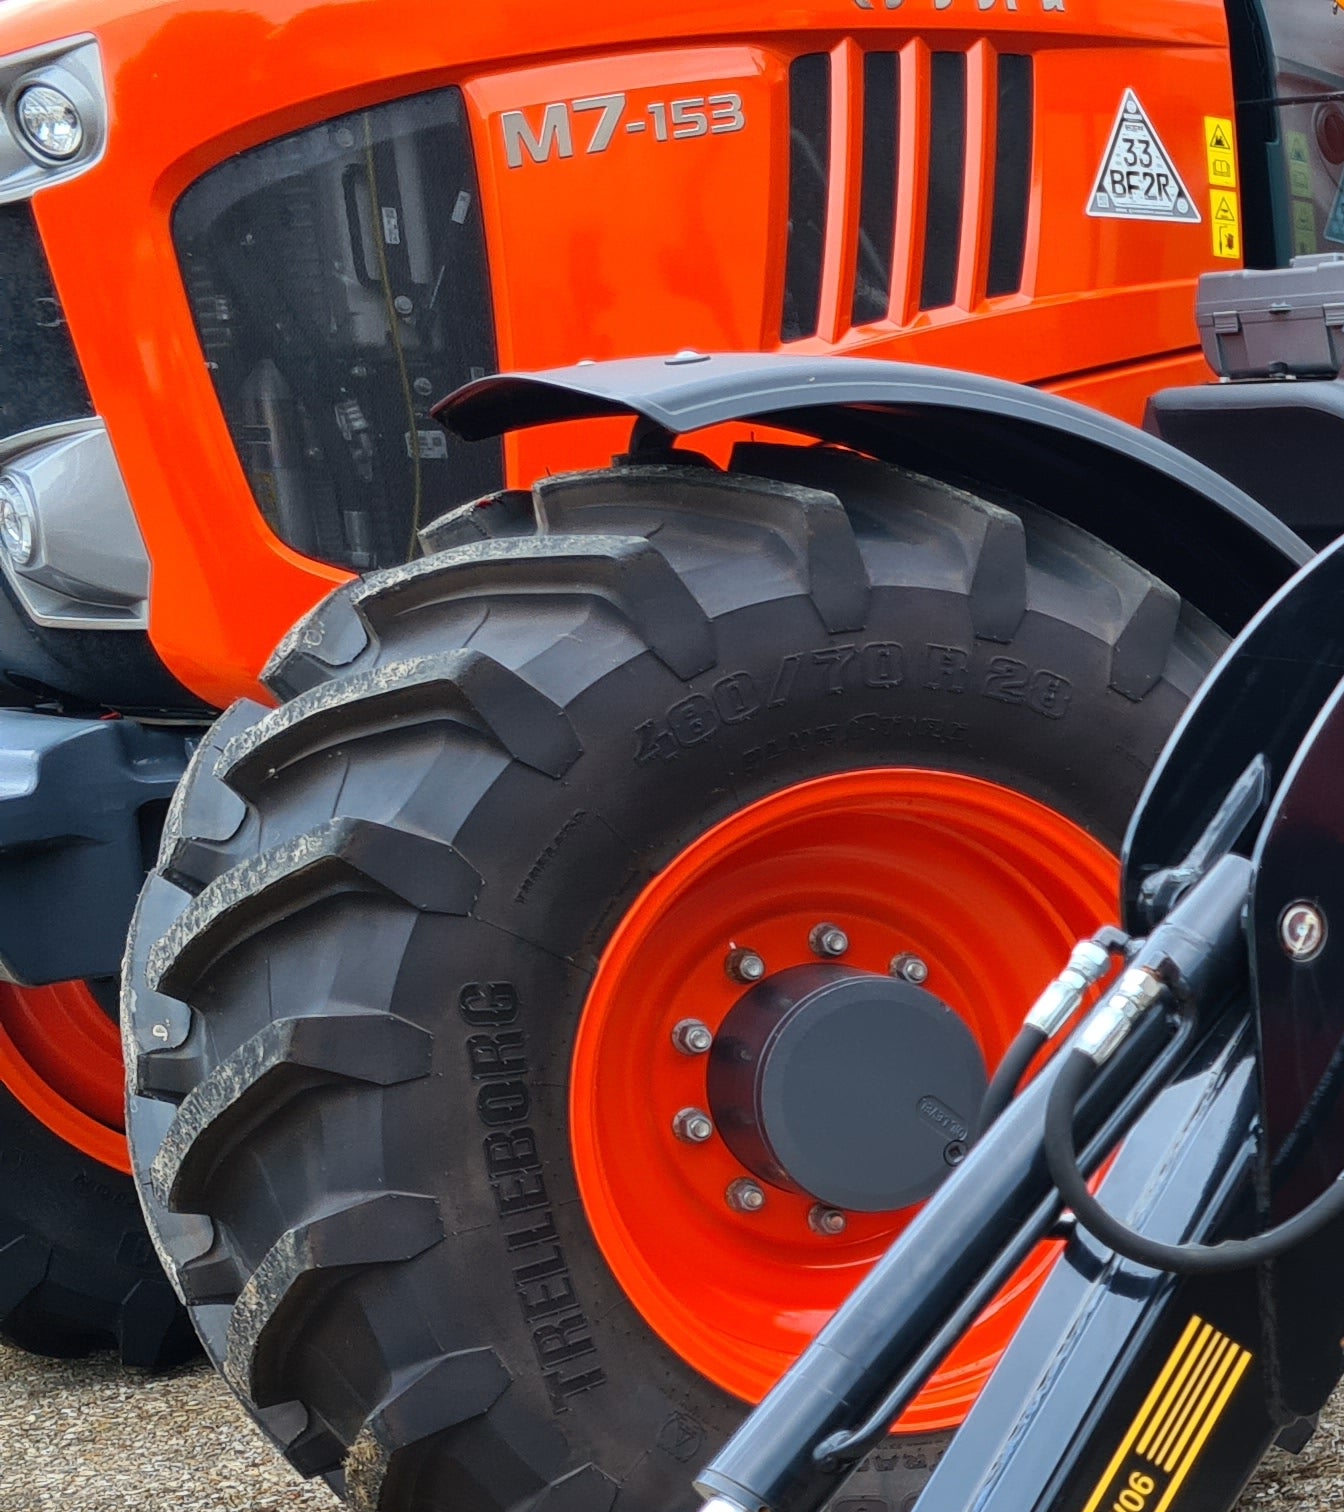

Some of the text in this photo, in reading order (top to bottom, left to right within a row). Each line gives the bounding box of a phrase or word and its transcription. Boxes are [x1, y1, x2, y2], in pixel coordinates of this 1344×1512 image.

[501, 93, 745, 168] M7-153
[1122, 138, 1152, 168] 33
[1110, 169, 1172, 202] BF2R
[459, 981, 607, 1414] TRELLEBORG
